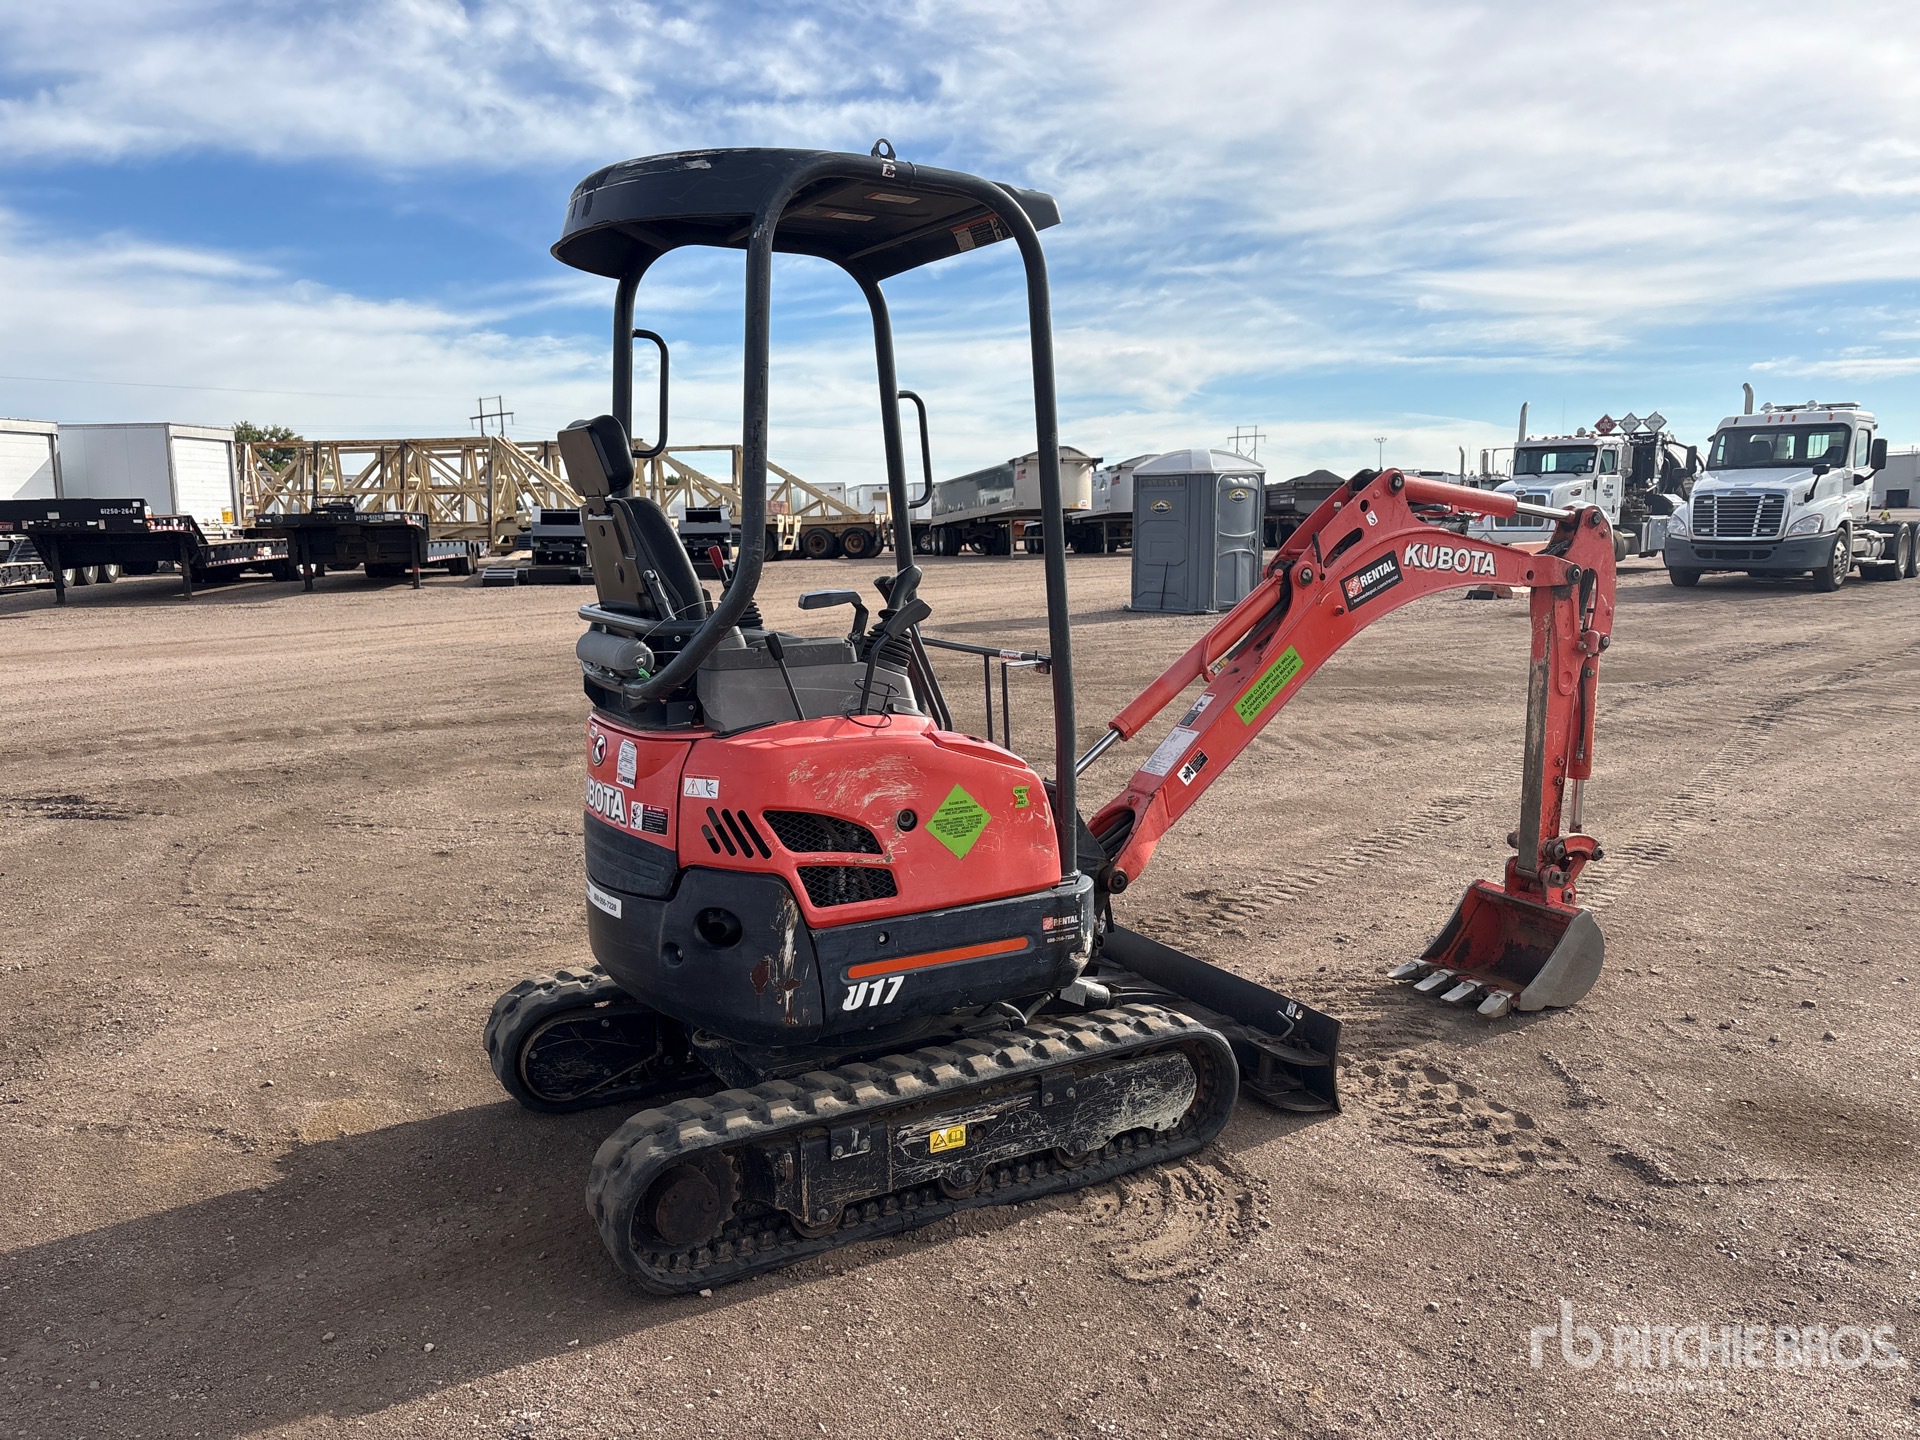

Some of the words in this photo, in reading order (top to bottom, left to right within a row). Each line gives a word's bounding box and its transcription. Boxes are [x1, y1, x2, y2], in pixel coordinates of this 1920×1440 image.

[1360, 560, 1396, 588] RENTAL
[1403, 543, 1496, 576] KUBOTA
[1240, 708, 1248, 717] BE
[1246, 688, 1267, 710] CHARGED
[1270, 674, 1280, 685] THIS
[1279, 654, 1298, 676] MACHINE
[1253, 672, 1274, 695] CLEANING
[1272, 663, 1281, 674] FEE
[1281, 654, 1292, 665] WILL
[1253, 701, 1263, 712] NOT
[1263, 679, 1284, 702] RETURNED
[1282, 664, 1297, 680] CLEAN
[588, 775, 626, 823] BOTA
[1053, 915, 1079, 927] RENTAL
[842, 975, 905, 1011] U17
